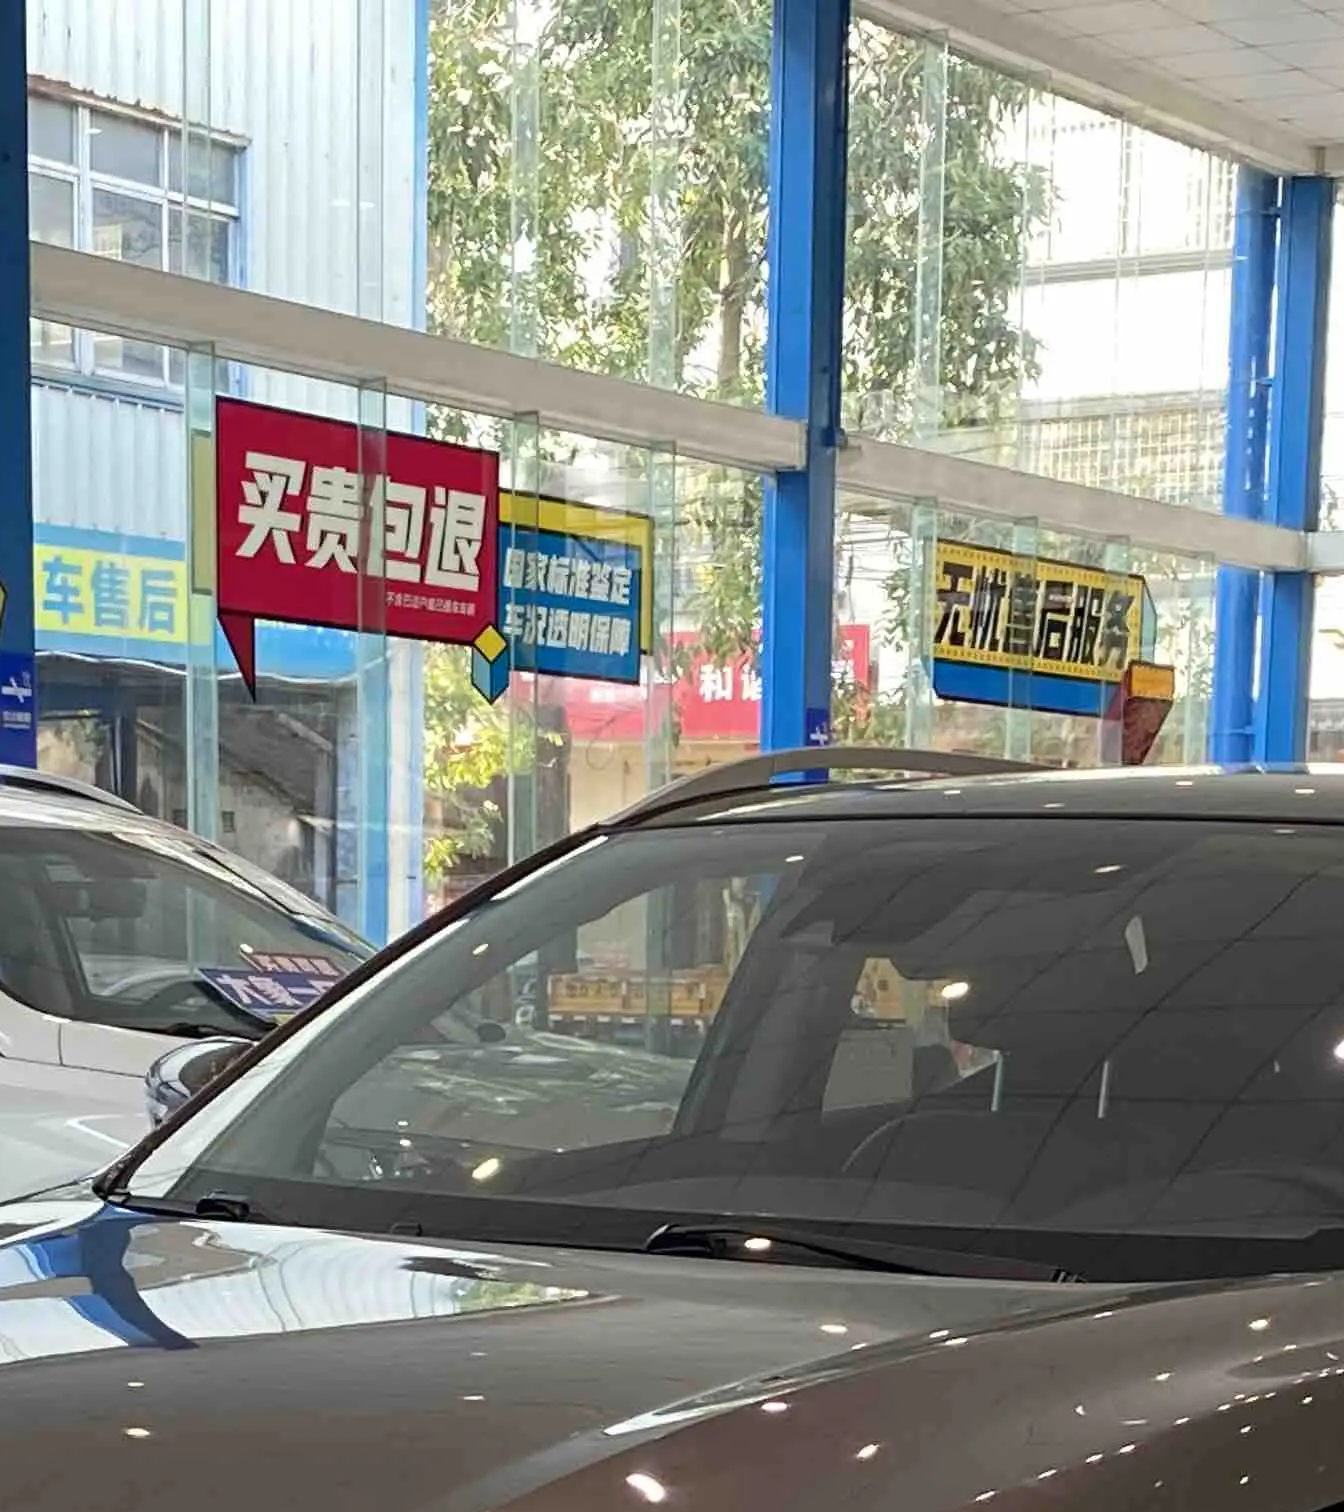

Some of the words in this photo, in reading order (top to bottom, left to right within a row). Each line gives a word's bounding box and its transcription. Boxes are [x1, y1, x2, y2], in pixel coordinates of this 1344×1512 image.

[235, 451, 487, 593] 买贵包退
[41, 555, 178, 634] 车售后
[503, 547, 632, 605] 国家标准鉴定
[933, 561, 1135, 670] 无忧售后服务
[503, 602, 632, 657] 车况透明保障
